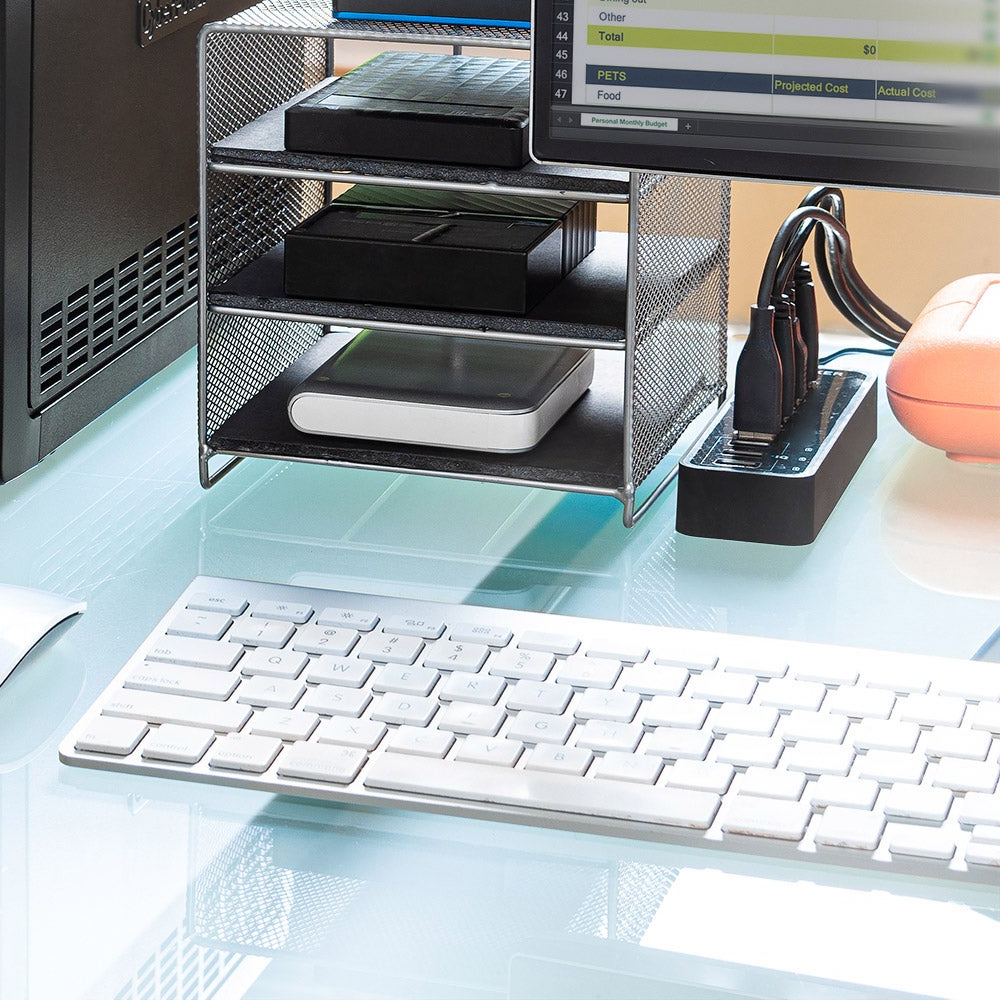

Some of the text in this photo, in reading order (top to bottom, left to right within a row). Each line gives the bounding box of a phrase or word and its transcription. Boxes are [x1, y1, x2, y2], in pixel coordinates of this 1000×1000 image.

[556, 12, 569, 21] 43
[599, 12, 626, 22] Other
[556, 31, 568, 41] 44
[598, 31, 624, 41] Total
[556, 50, 568, 59] 45
[863, 45, 876, 55] $0
[555, 69, 567, 79] 46
[598, 70, 626, 81] PETS
[775, 80, 848, 94] Projected Cost
[555, 89, 567, 98] 47
[597, 90, 621, 101] Food
[878, 86, 936, 98] Actual Cost
[620, 119, 644, 127] Monthly
[645, 120, 667, 128] Budget
[268, 656, 282, 664] Q
[333, 664, 350, 672] W
[467, 681, 478, 689] R
[535, 721, 548, 729] G
[554, 753, 565, 761] B
